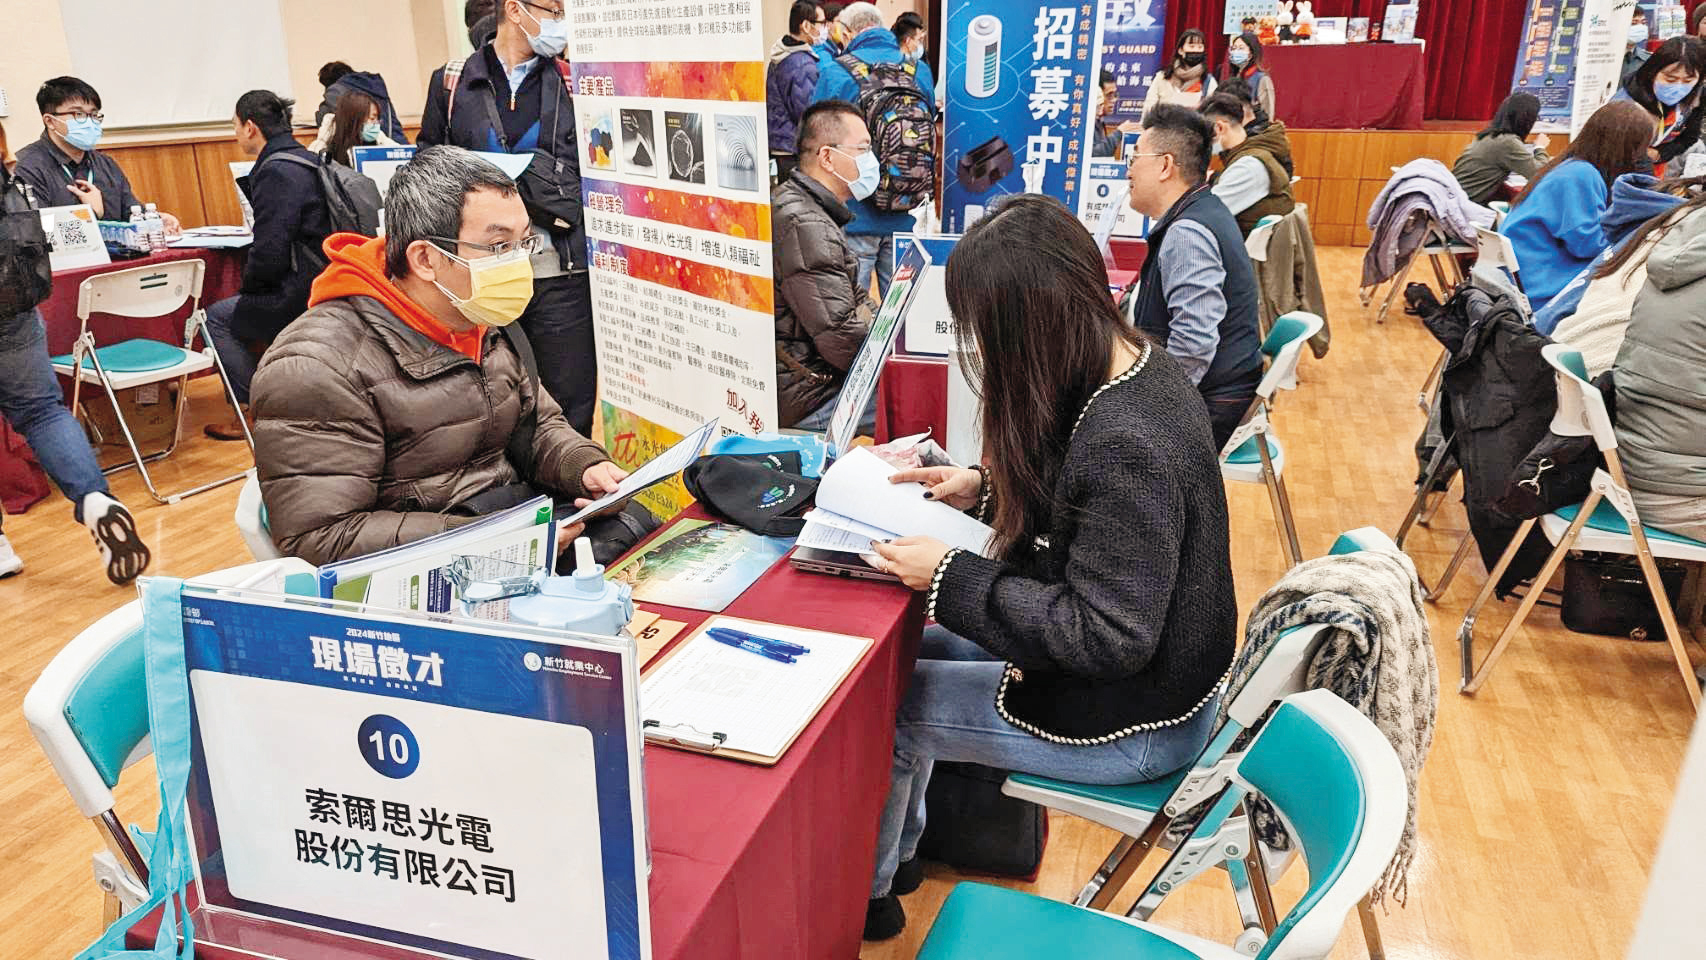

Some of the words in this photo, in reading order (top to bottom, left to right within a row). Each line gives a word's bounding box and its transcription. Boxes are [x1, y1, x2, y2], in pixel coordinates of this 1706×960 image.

[1118, 45, 1156, 54] GUARD
[578, 75, 615, 96] 主要產品
[1026, 6, 1076, 180] 招募中
[588, 191, 624, 215] 經營理念
[594, 252, 629, 276] 福利制度
[701, 239, 761, 267] 增進人類福祉
[309, 635, 444, 687] 現場徵才
[544, 656, 605, 674] 新竹就業中心
[368, 729, 409, 766] 10
[305, 786, 493, 855] 索爾思光電
[296, 828, 517, 904] 股份有限公司
